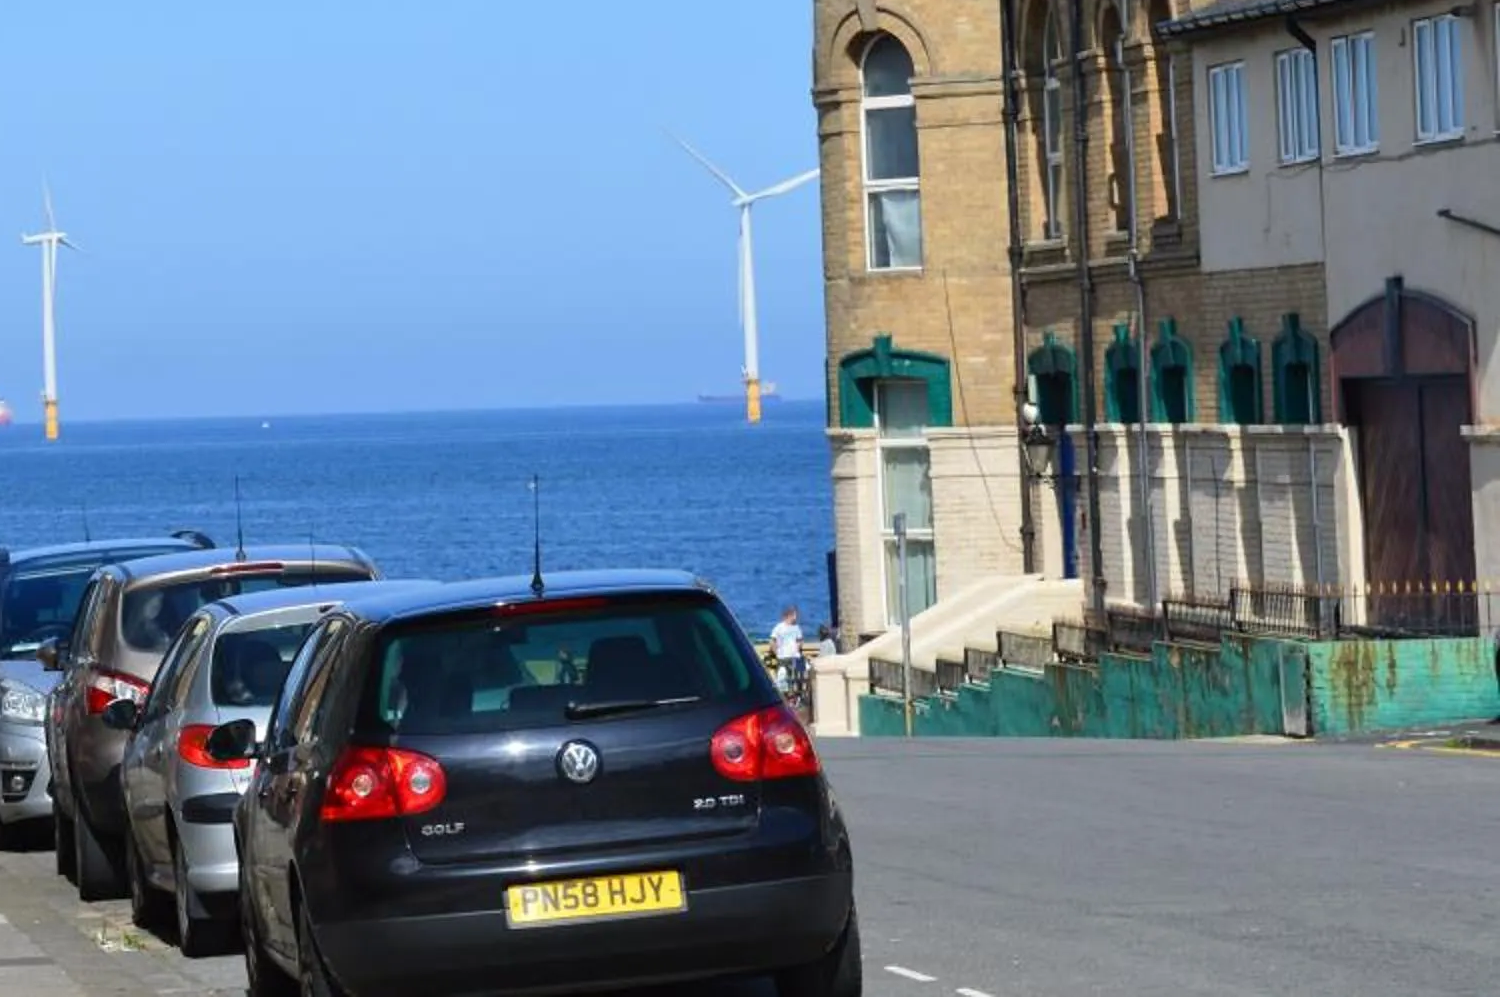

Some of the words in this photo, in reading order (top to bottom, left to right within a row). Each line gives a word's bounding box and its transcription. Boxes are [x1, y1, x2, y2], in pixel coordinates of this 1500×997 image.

[421, 822, 465, 837] GOLF
[520, 881, 599, 916] PN58
[608, 875, 664, 907] HJY
